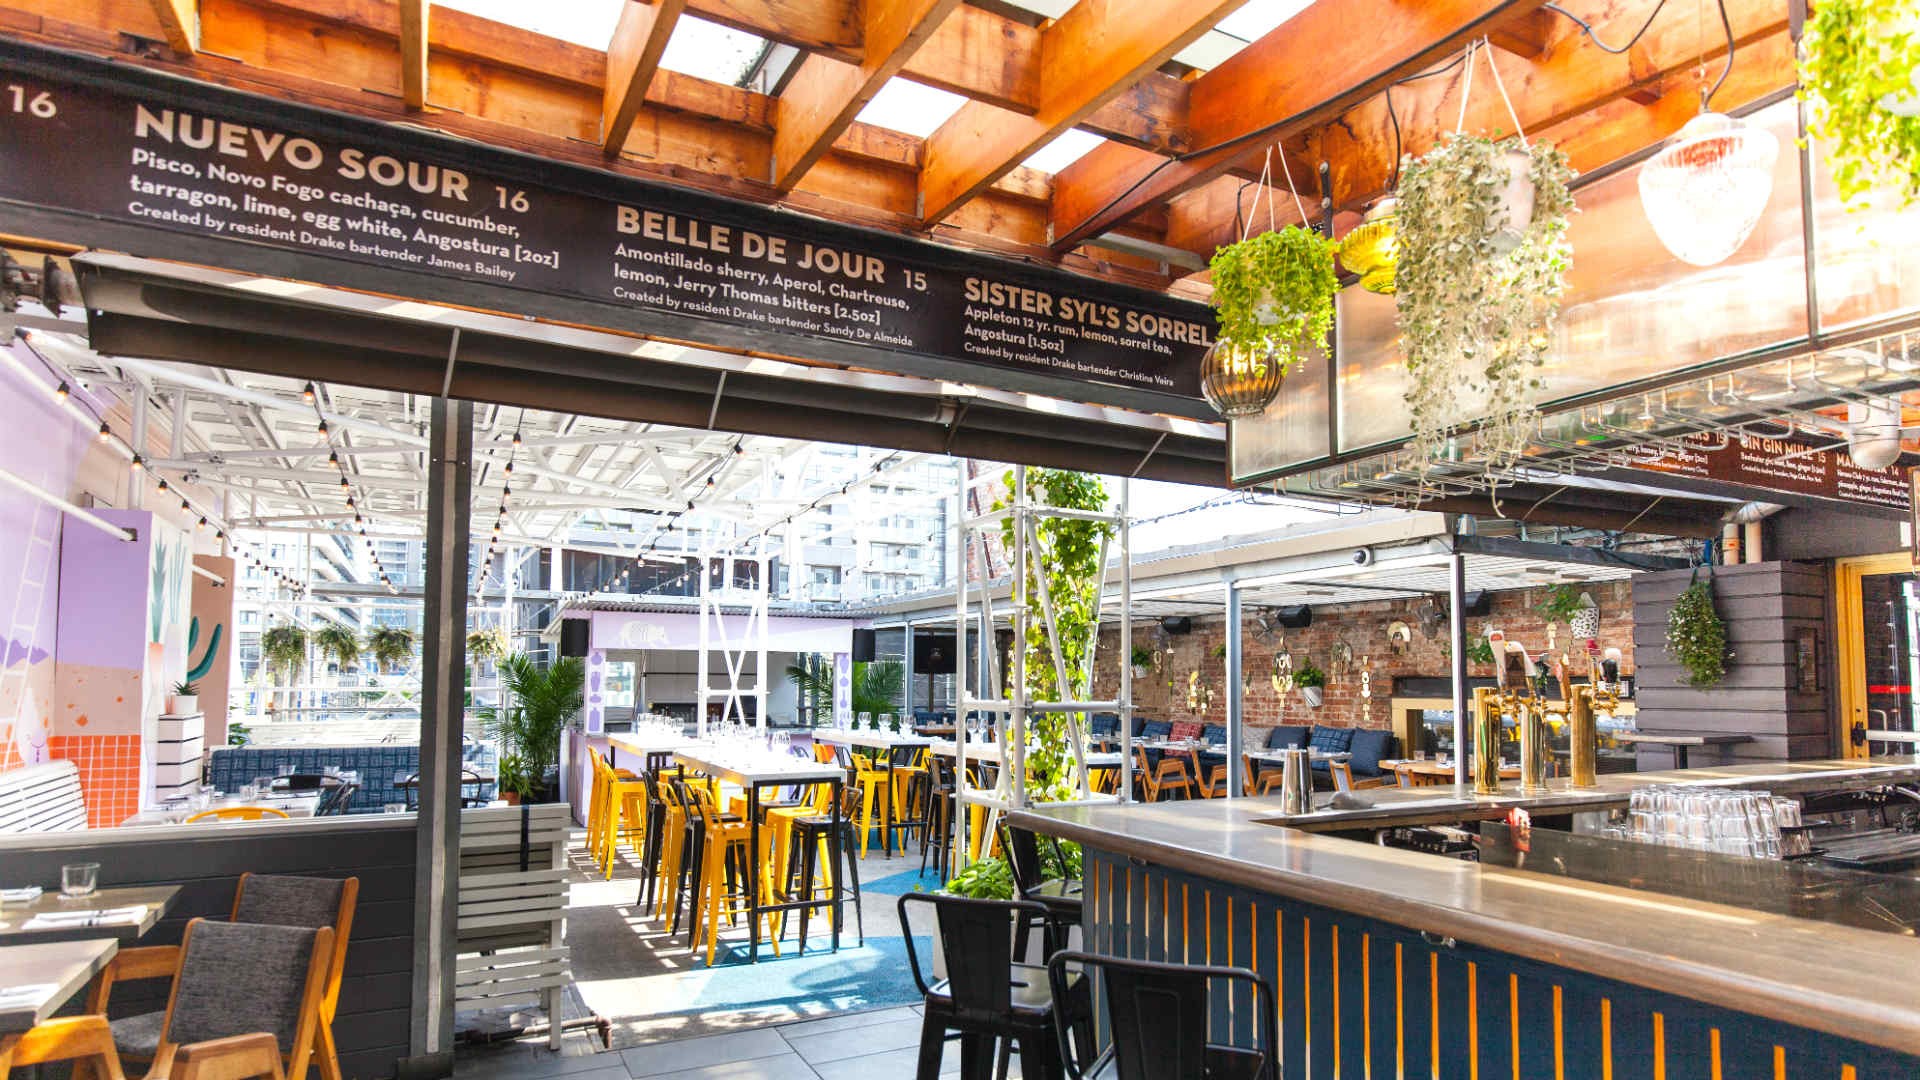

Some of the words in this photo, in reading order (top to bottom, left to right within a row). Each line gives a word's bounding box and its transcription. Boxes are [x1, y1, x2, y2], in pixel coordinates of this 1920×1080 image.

[8, 85, 56, 118] 16
[135, 105, 322, 169] NUEVO
[338, 150, 468, 201] SOUR
[496, 187, 529, 212] 16
[131, 176, 238, 211] tarragon,
[244, 194, 297, 222] lime,
[302, 212, 341, 231] egg
[345, 216, 408, 241] white,
[412, 228, 510, 258] Angostura
[132, 148, 201, 178] Pisco,
[208, 163, 266, 188] Novo
[272, 175, 324, 201] Fogo
[330, 192, 416, 219] cachaça,
[422, 210, 520, 238] cucumber,
[128, 202, 202, 226] Created
[204, 214, 226, 232] by
[229, 222, 296, 242] resident
[300, 231, 346, 250] Drake
[349, 239, 424, 263] bartender
[427, 254, 472, 272] James
[475, 262, 516, 281] Bailey
[617, 206, 730, 253] BELLE
[743, 232, 786, 264] DE
[797, 245, 884, 283] JOUR
[904, 270, 926, 290] 15
[614, 262, 669, 288] lemon,
[674, 276, 716, 298] Jerry
[720, 283, 779, 306] Thomas
[782, 293, 831, 314] bitters
[615, 243, 712, 272] Amontillado
[718, 262, 768, 286] sherry,
[772, 273, 825, 295] Aperol,
[829, 284, 909, 310] Chartreuse,
[613, 286, 664, 305] Created
[666, 295, 681, 311] by
[683, 300, 730, 317] resident
[733, 307, 766, 322] Drake
[768, 312, 821, 332] bartender
[823, 322, 855, 339] Sandy
[857, 328, 872, 340] De
[874, 331, 912, 346] Almeida
[965, 278, 1052, 316] SISTER
[1126, 312, 1214, 348] SORREL
[965, 304, 1020, 325] Appleton
[1022, 318, 1033, 329] 12
[1054, 325, 1078, 337] rum,
[1082, 326, 1117, 344] lemon,
[1120, 338, 1150, 350] sorrel
[965, 324, 1025, 344] Angostura
[965, 342, 1000, 356] Created
[1003, 348, 1013, 360] by
[1016, 354, 1049, 365] resident
[1052, 358, 1075, 369] Drake
[1078, 362, 1117, 376] bartender
[1740, 434, 1760, 450] GIN
[1763, 439, 1782, 454] GIN
